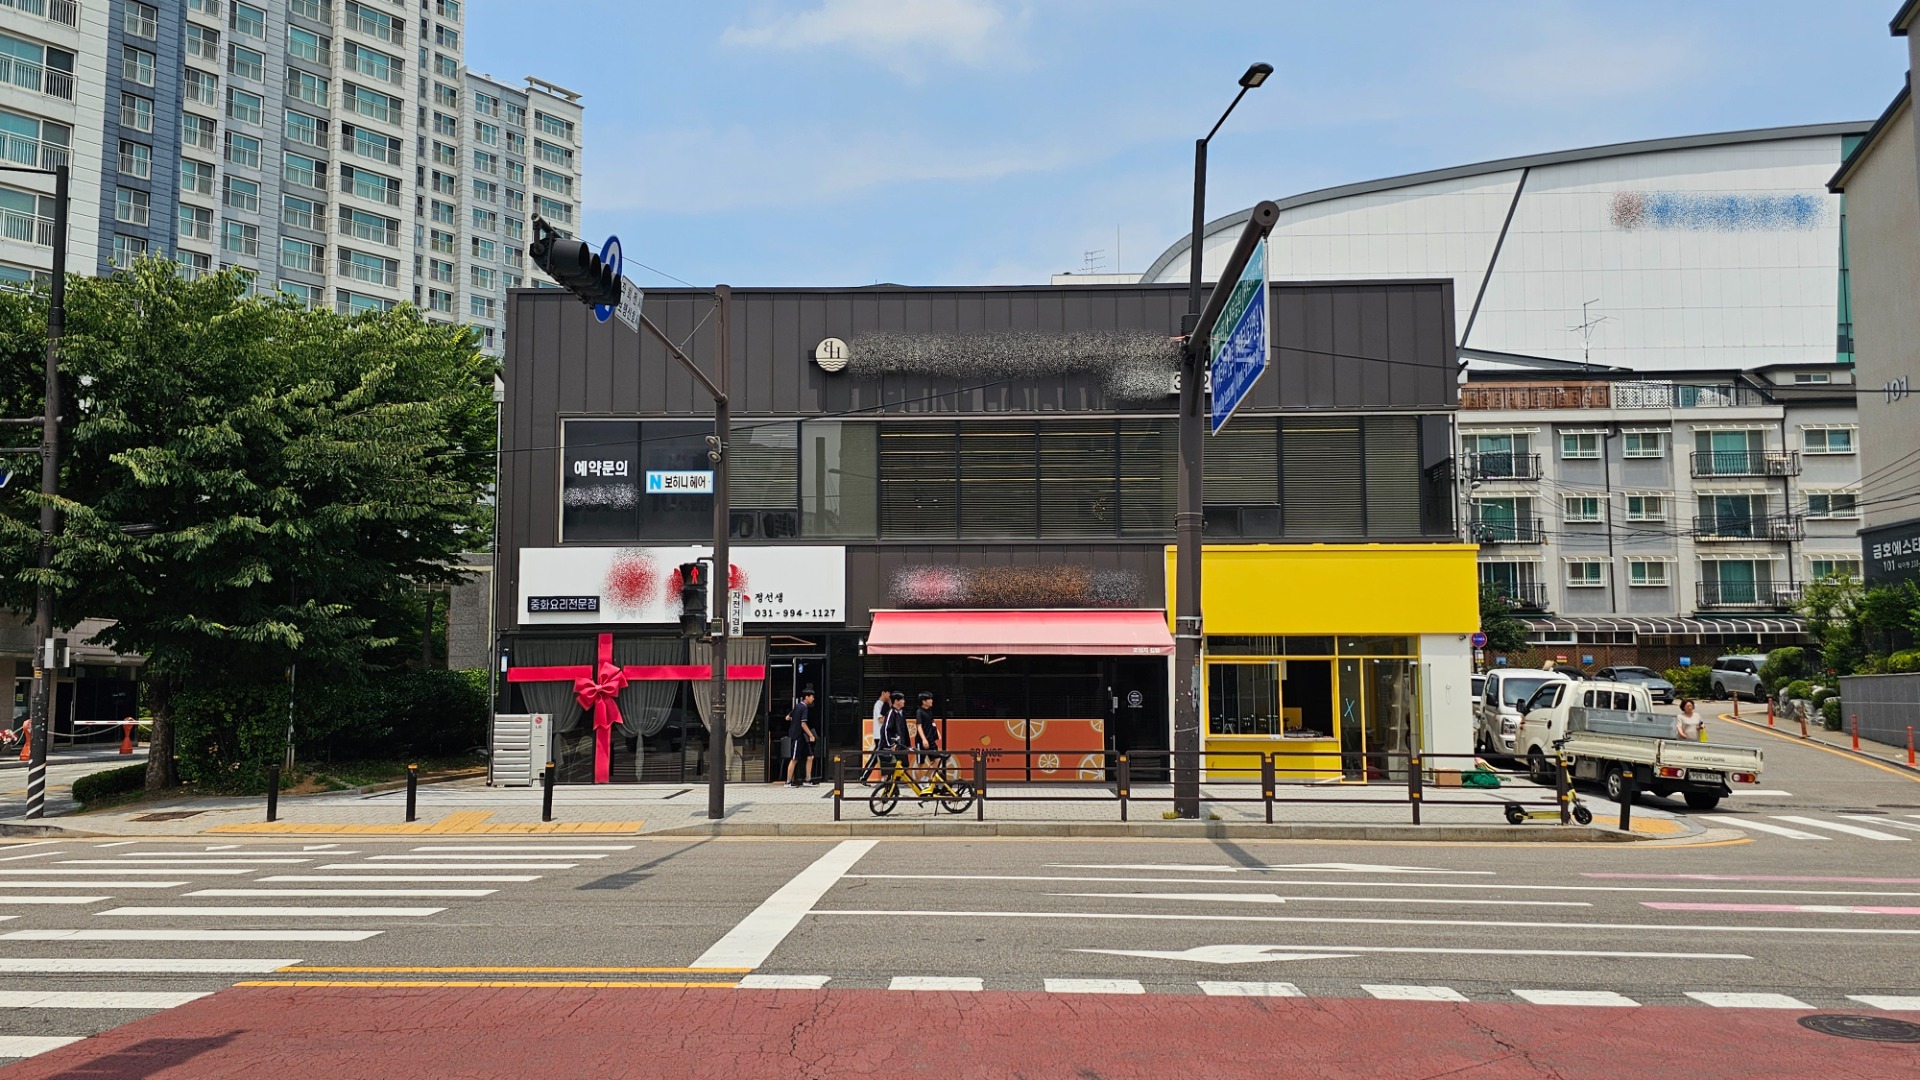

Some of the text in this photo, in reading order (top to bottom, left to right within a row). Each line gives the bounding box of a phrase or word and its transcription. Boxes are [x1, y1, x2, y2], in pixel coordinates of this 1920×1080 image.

[1882, 375, 1909, 404] 101
[573, 459, 628, 477] 예약문의
[1882, 559, 1895, 572] 101
[754, 591, 784, 603] 정선생
[530, 598, 597, 611] 중화요리전문점
[754, 608, 836, 618] 031-994-1127
